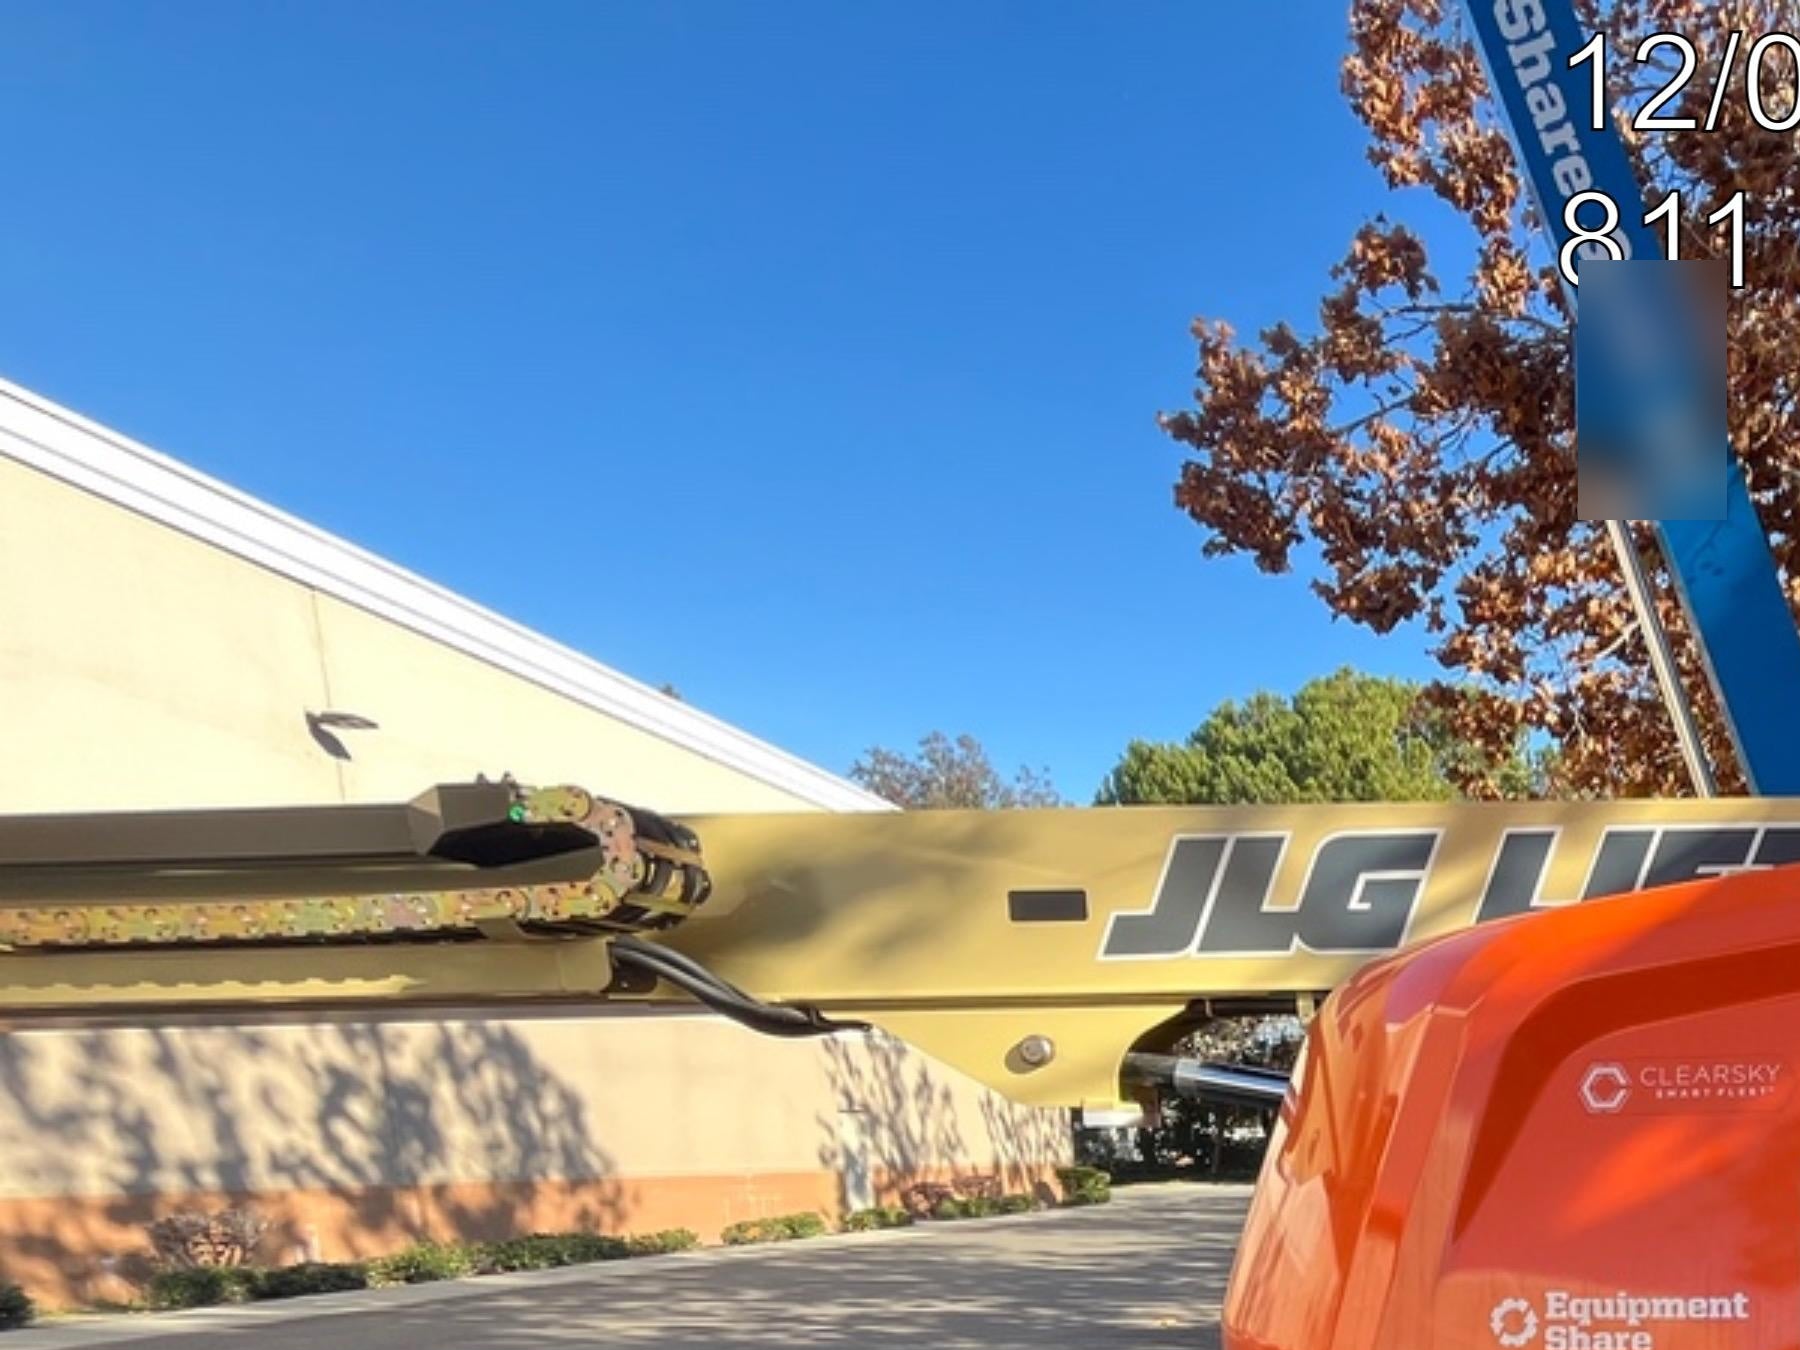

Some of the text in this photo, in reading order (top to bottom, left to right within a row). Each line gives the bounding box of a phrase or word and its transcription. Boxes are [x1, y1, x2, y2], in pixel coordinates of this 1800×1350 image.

[1097, 828, 1446, 960] JLG
[1639, 1064, 1781, 1087] CLEARSKY
[1655, 1088, 1711, 1100] SMART
[1544, 1291, 1750, 1326] Equipment
